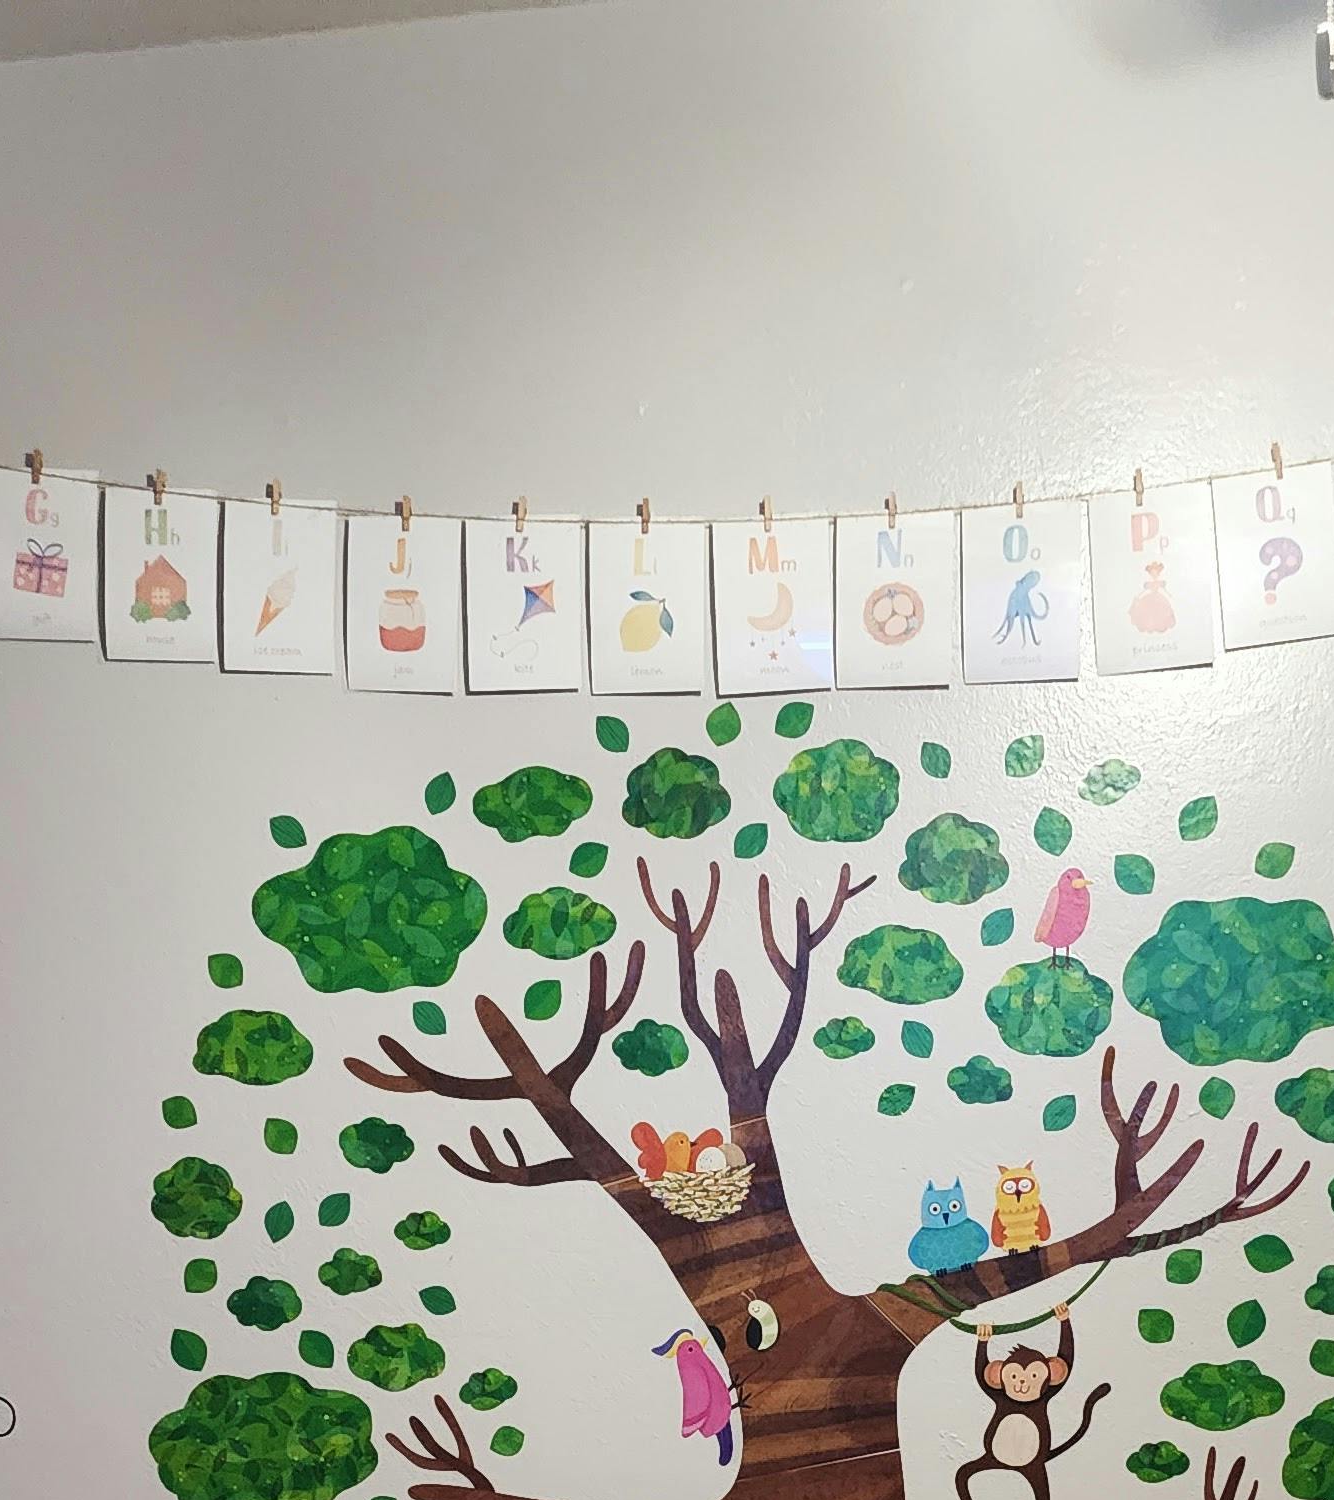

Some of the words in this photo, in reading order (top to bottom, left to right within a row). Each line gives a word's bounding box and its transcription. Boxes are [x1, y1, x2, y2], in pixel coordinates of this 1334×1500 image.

[25, 489, 60, 528] Gg
[1255, 485, 1296, 525] Qq
[144, 508, 180, 545] Hh
[1002, 524, 1041, 563] Oo
[1131, 511, 1169, 556] Pp
[506, 536, 541, 573] Kk
[748, 536, 797, 574] Mm
[876, 530, 913, 568] Nn
